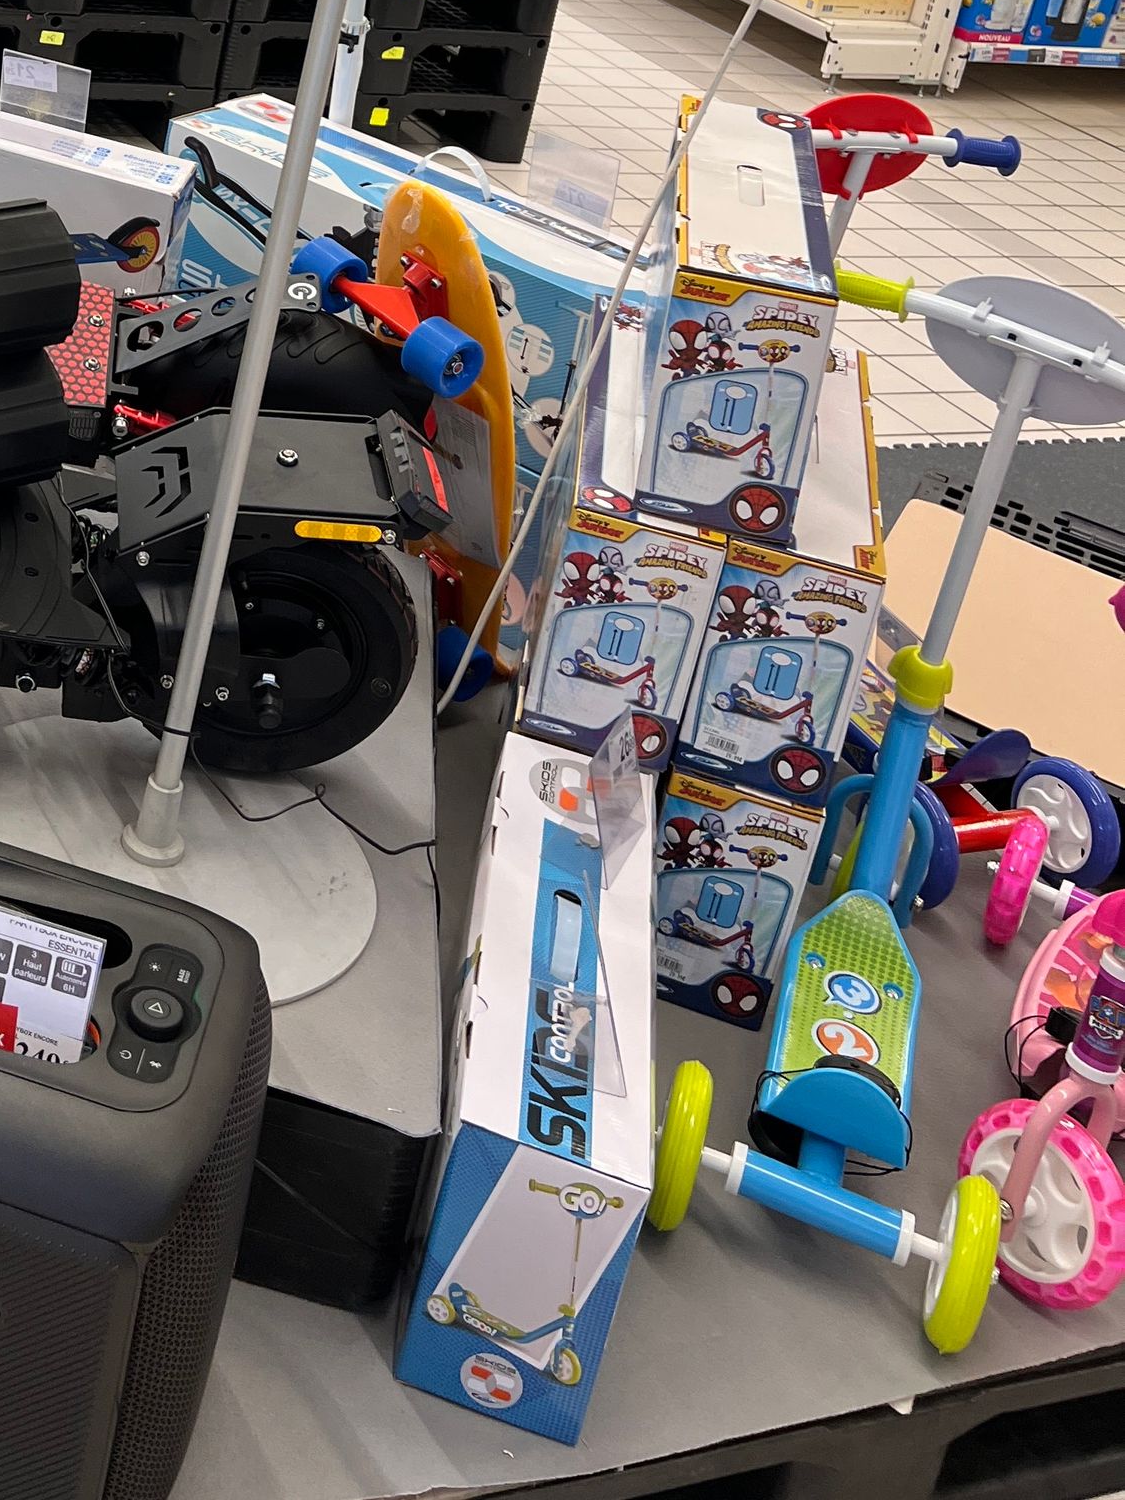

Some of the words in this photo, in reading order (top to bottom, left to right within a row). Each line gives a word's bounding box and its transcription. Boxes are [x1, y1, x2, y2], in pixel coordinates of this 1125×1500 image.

[978, 32, 1011, 42] NOUVEAU
[752, 304, 819, 328] SPIDEY
[746, 320, 786, 332] AMAZING
[786, 321, 821, 338] FRIENDS
[637, 557, 674, 570] AMAZING
[674, 560, 708, 579] FRIENDS
[644, 544, 708, 569] SPIDEY
[795, 590, 833, 605] AMAZING
[833, 594, 868, 613] FRIENDS
[802, 578, 868, 603] SPIDEY
[539, 761, 553, 802] SKIDS
[740, 825, 775, 840] AMAZING
[775, 829, 808, 850] FRIENDS
[747, 814, 810, 840] SPIDEY
[31, 950, 37, 958] 3
[48, 939, 98, 961] ESSENTIAL
[14, 968, 47, 984] parleurs
[23, 958, 43, 972] Haut
[62, 984, 75, 994] 6H
[526, 987, 588, 1159] SKIDS
[559, 1185, 606, 1216] GO!
